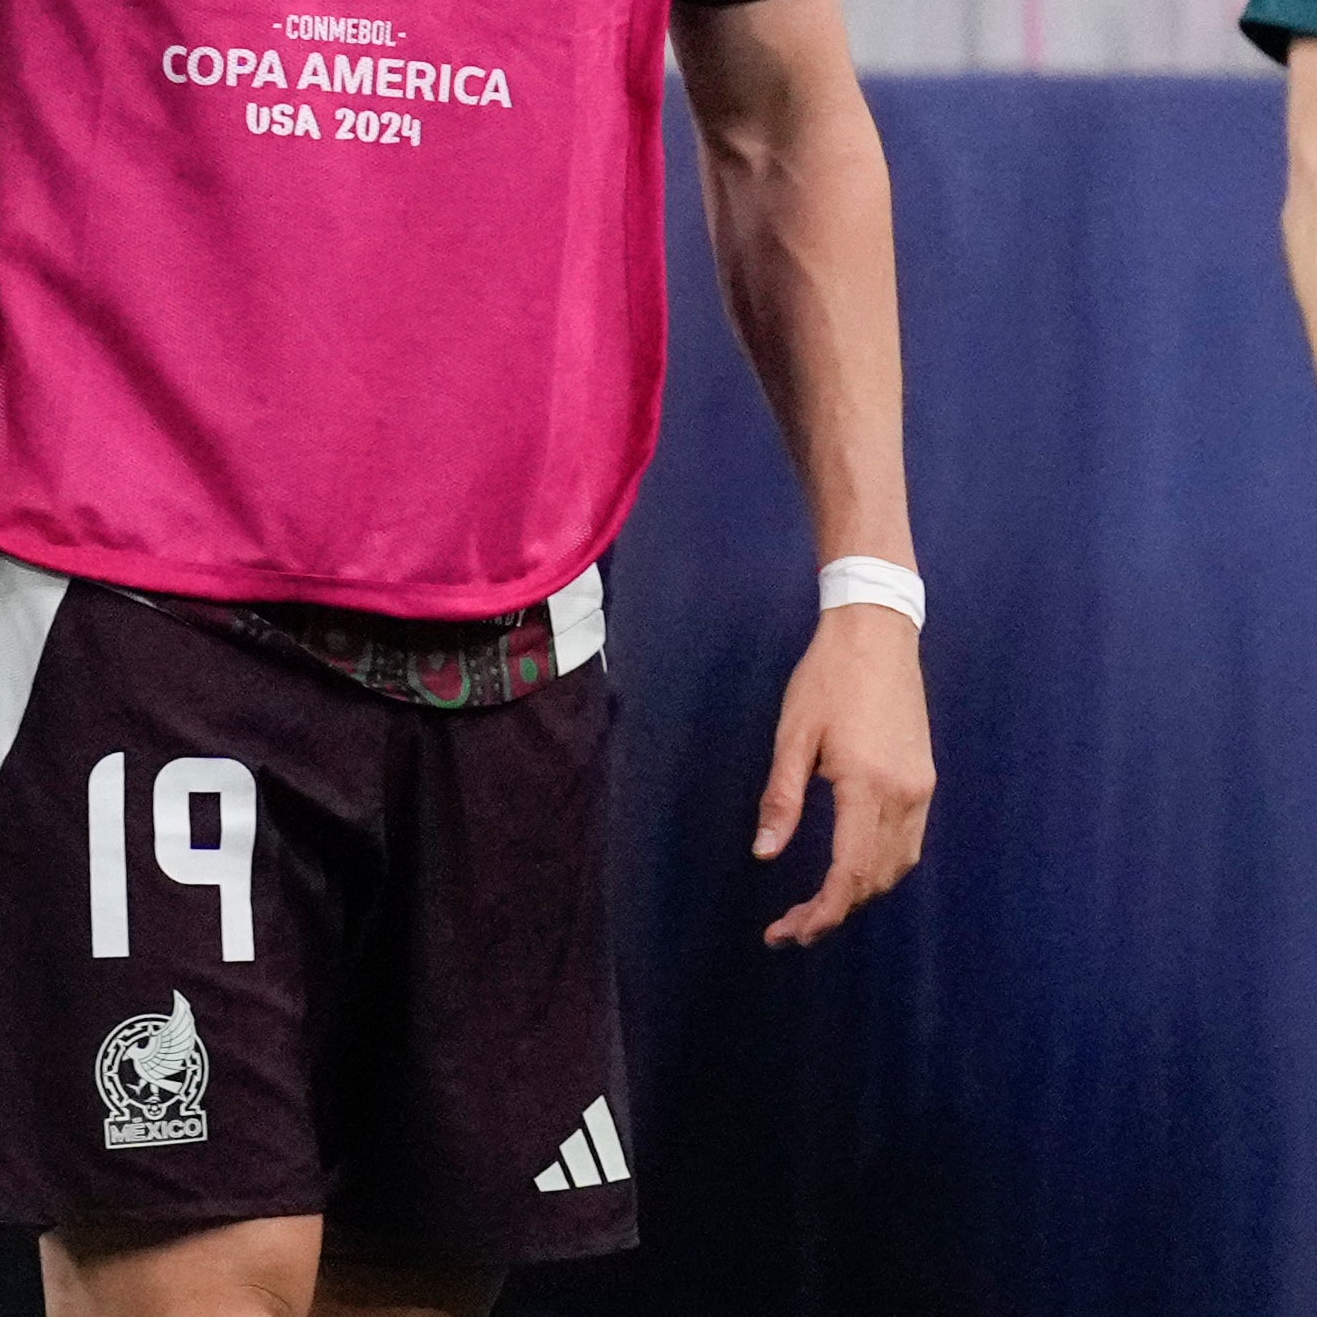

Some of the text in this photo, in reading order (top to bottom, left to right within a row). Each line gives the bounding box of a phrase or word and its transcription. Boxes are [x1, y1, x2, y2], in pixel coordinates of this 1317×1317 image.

[162, 45, 513, 109] COPA AMERICA
[245, 102, 423, 148] USA 2024
[88, 751, 257, 962] 19
[109, 1117, 202, 1145] MÉXICO
